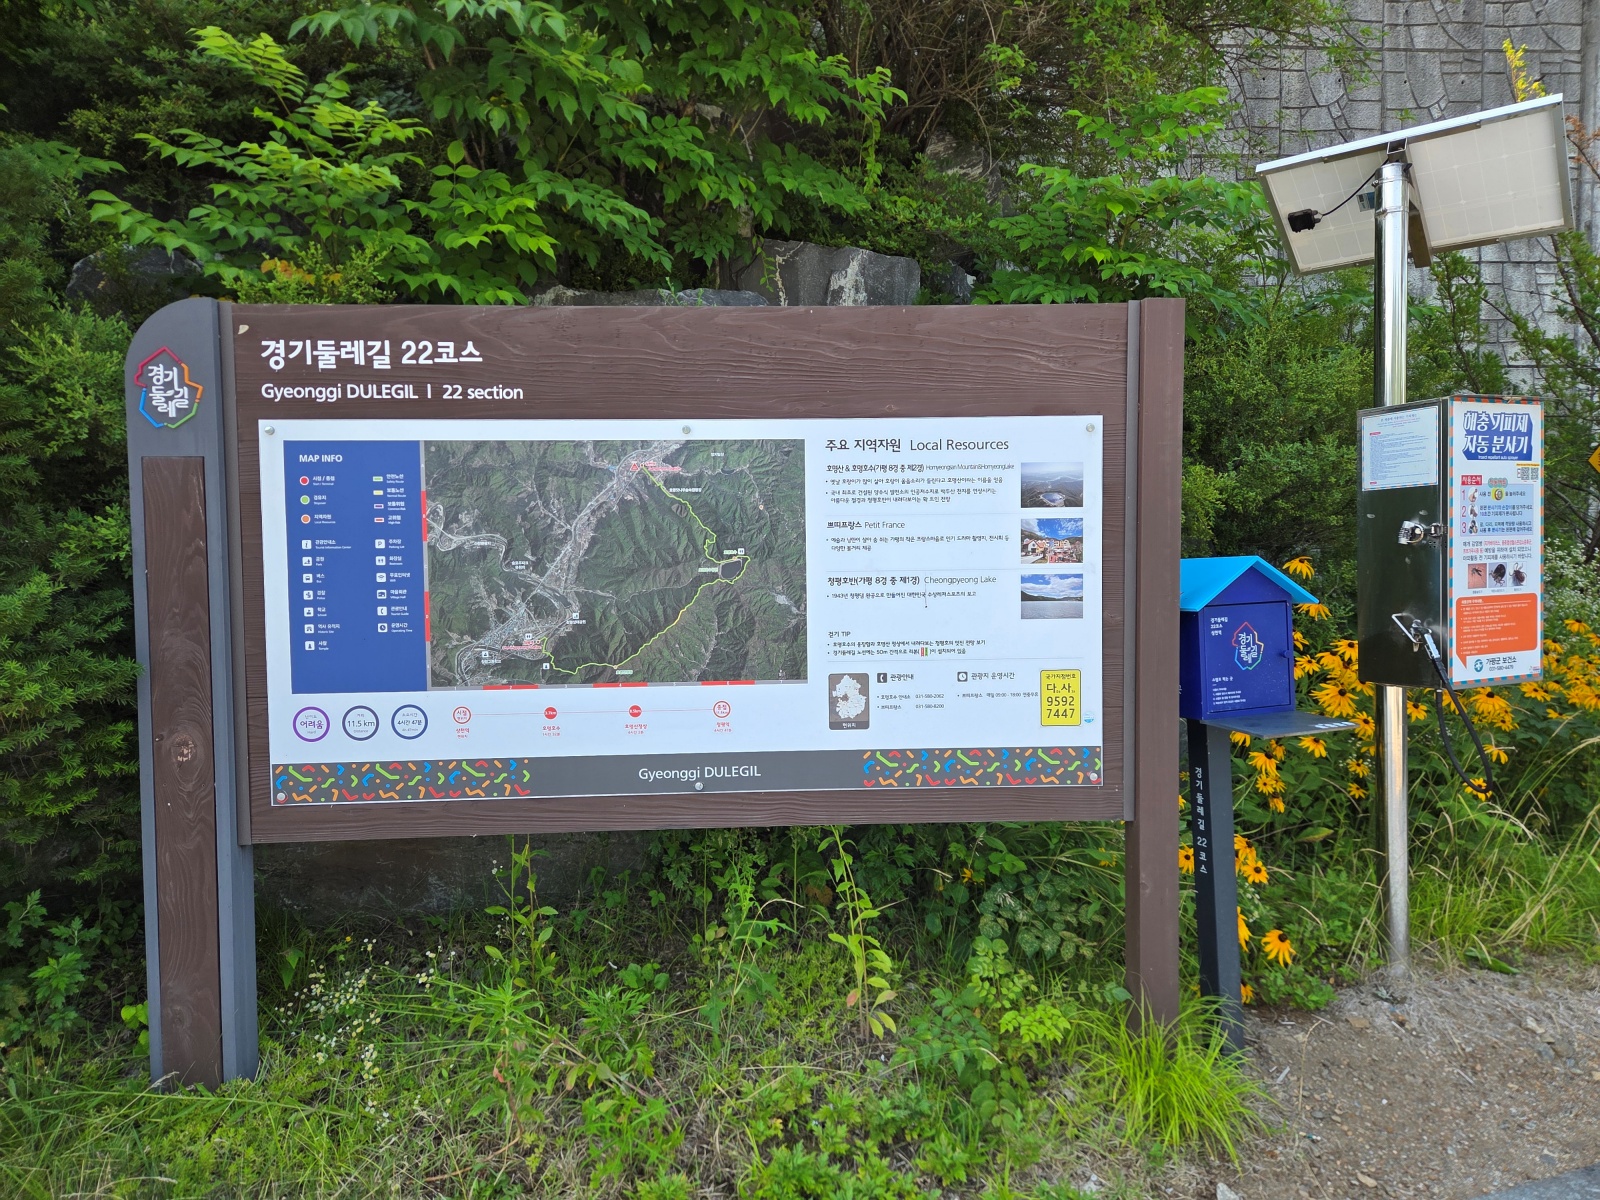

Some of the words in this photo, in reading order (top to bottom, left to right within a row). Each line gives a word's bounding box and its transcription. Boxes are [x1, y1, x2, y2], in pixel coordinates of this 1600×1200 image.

[261, 339, 391, 370] 경기둘레길
[401, 341, 483, 365] 22코스
[261, 383, 341, 402] Gyeonggi
[346, 384, 419, 399] DULEGIL
[442, 385, 463, 400] 22
[467, 385, 524, 400] section
[1463, 412, 1489, 431] 해충
[1491, 413, 1528, 433] 기피제
[825, 439, 849, 451] 주요
[854, 439, 901, 453] 지역자원
[910, 439, 942, 451] Local
[947, 439, 1009, 451] Resources
[1462, 434, 1489, 454] 자동
[1491, 435, 1528, 454] 분사기
[299, 454, 320, 463] MAP
[321, 454, 343, 463] INFO
[826, 465, 844, 473] 호명산
[851, 464, 887, 473] 호명호수(가평
[888, 465, 899, 473] 8경
[900, 465, 905, 473] 중
[907, 464, 924, 473] 제2경)
[1462, 489, 1465, 500] 1
[1461, 505, 1466, 518] 2
[864, 521, 880, 529] Petit
[1461, 522, 1466, 534] 3
[827, 576, 873, 586] 청평호반(가평
[875, 576, 887, 585] 8경
[890, 576, 897, 585] 중
[899, 576, 920, 585] 제1경)
[924, 576, 978, 585] Cheongpyeong
[1485, 657, 1501, 665] 가평군
[890, 673, 914, 681] 관광안내
[971, 672, 989, 681] 관광지
[991, 672, 1015, 680] 운영시간
[1046, 683, 1056, 693] 다
[1060, 683, 1071, 693] 사
[1046, 696, 1074, 707] 9592
[1046, 708, 1075, 718] 7447
[300, 720, 324, 729] 어려움
[347, 720, 362, 728] 11.5
[638, 767, 701, 782] Gyeonggi
[704, 765, 762, 778] DULEGIL
[1194, 767, 1205, 831] 경기둘레길
